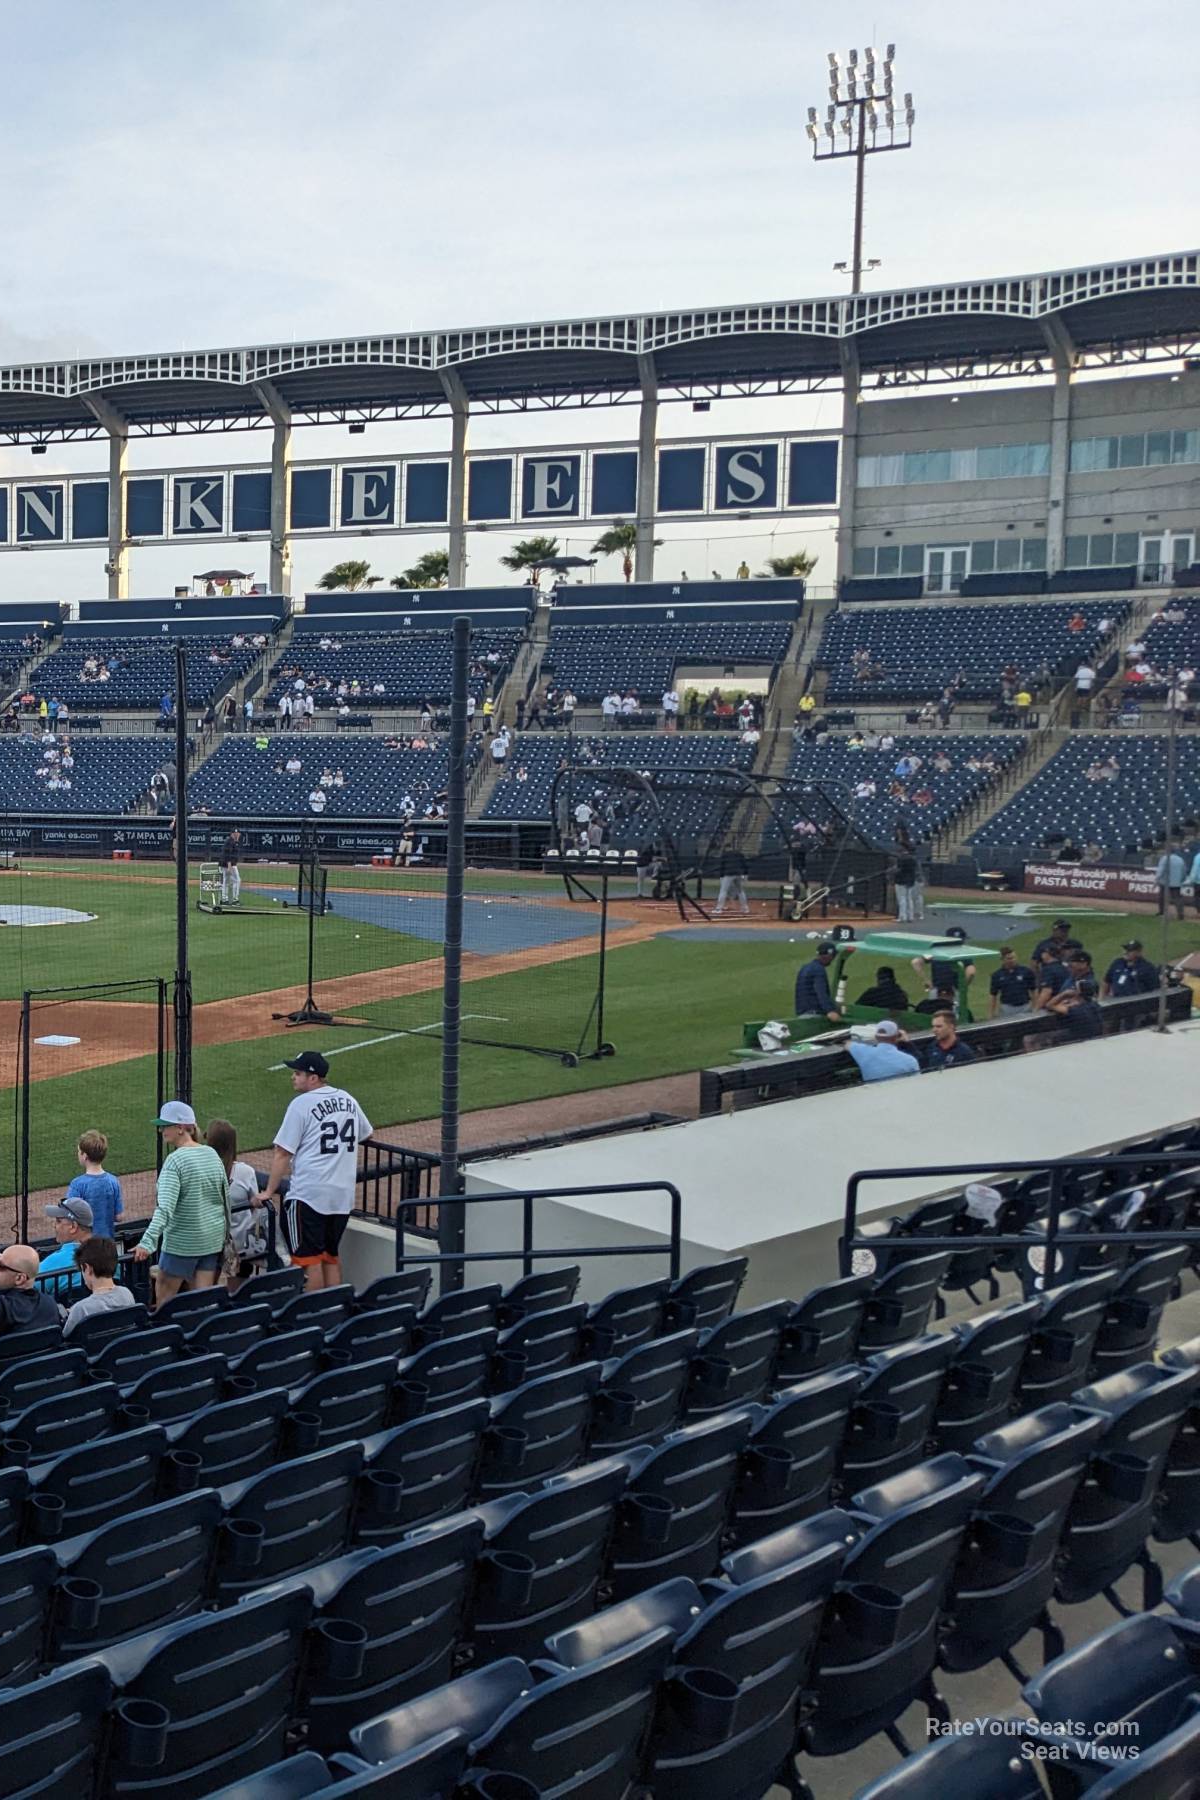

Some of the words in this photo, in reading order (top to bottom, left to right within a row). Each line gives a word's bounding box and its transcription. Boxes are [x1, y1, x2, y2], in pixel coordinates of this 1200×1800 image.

[16, 829, 32, 838] BAY
[1034, 876, 1068, 888] PASTA
[1070, 878, 1106, 890] SAUCE
[311, 1098, 356, 1122] CABRERA
[320, 1118, 356, 1154] 24
